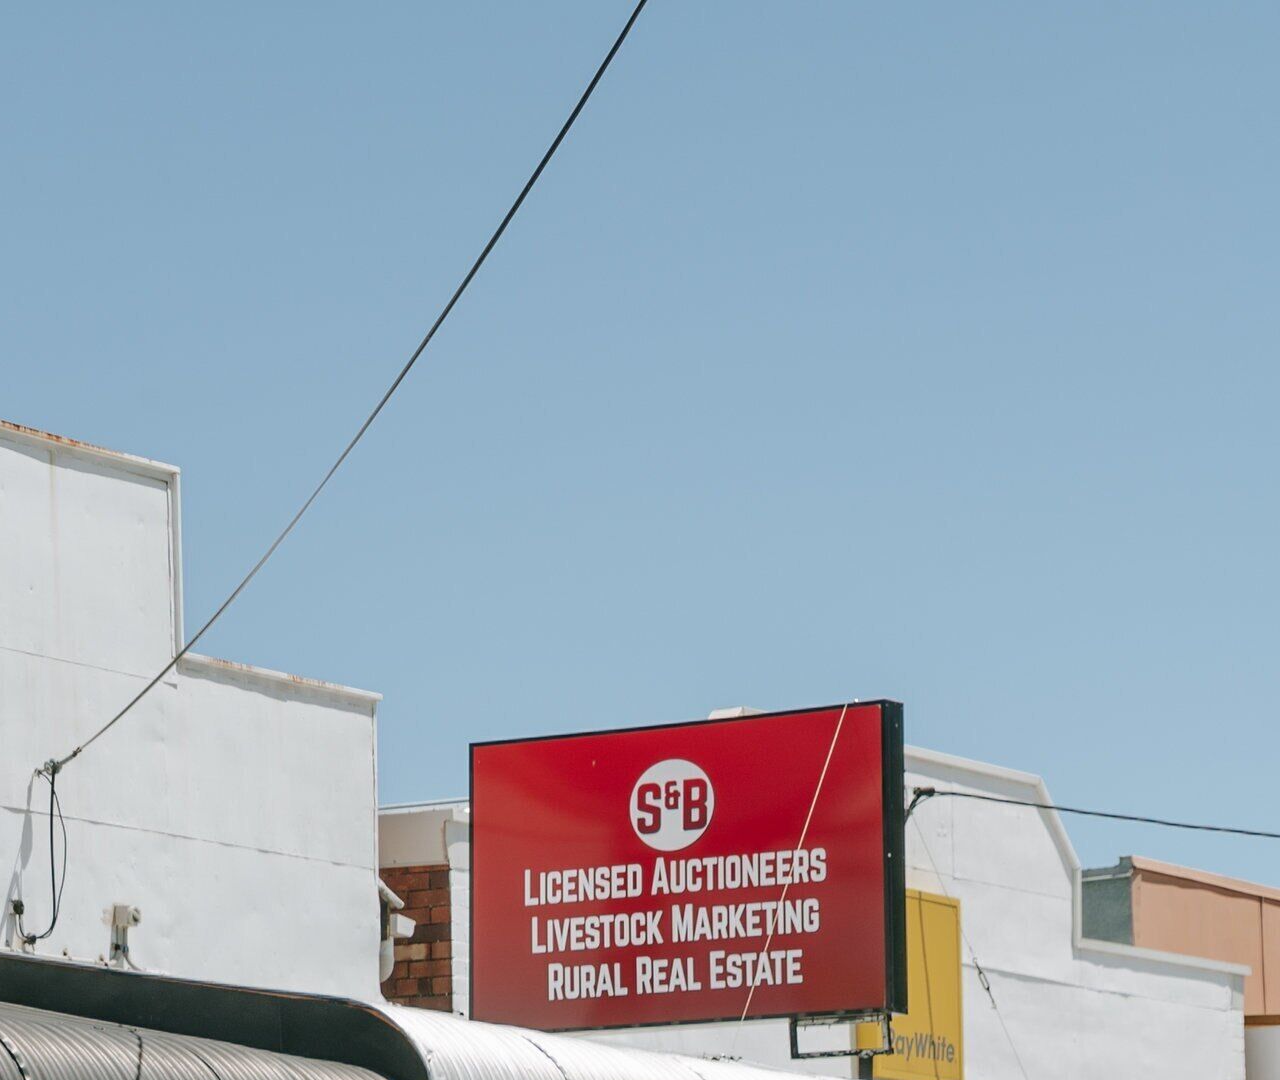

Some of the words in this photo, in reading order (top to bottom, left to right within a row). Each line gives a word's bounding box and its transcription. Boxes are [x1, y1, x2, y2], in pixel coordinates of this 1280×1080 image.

[636, 777, 708, 835] S&B
[524, 863, 643, 907] LICENSED
[651, 847, 828, 895] AUCTIONEERS
[531, 910, 663, 955] LIVESTOCK
[671, 898, 820, 940] MARKETING
[547, 962, 628, 1001] RURAL
[636, 956, 702, 994] REAL
[709, 948, 804, 988] ESTATE
